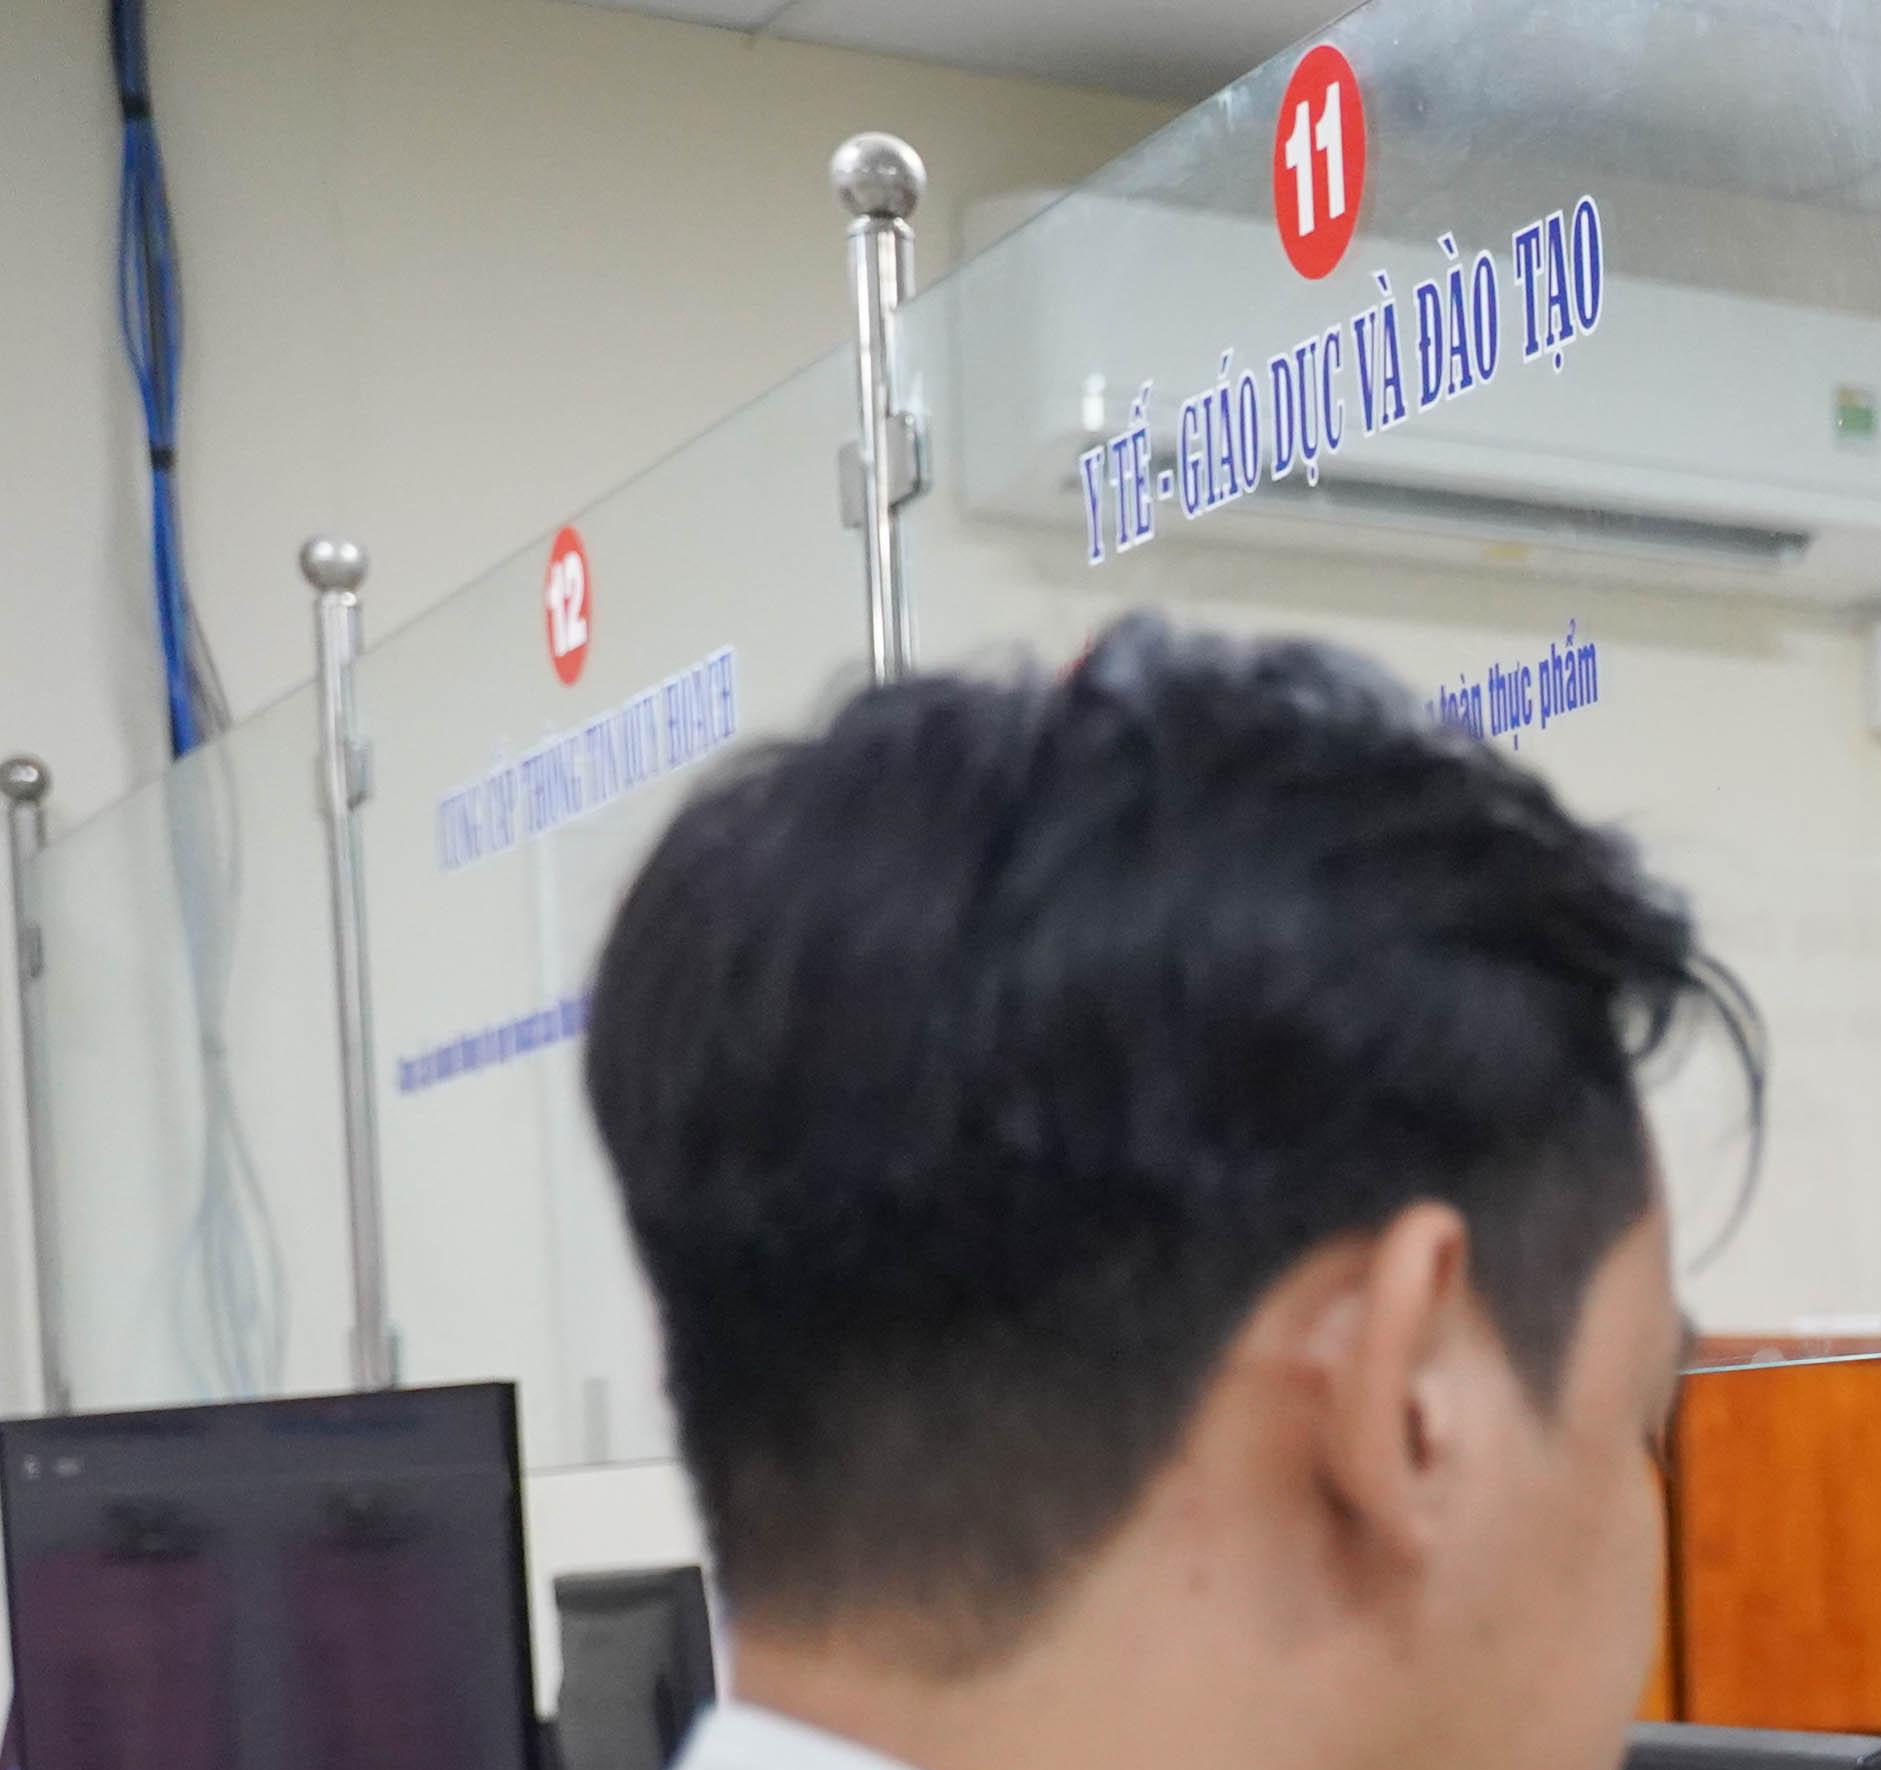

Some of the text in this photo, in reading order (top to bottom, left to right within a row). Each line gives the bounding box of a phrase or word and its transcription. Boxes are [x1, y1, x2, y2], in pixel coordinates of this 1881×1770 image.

[1284, 81, 1345, 236] 11
[1080, 452, 1104, 562] Y
[1110, 385, 1153, 547] TẾ
[1180, 350, 1260, 516] GIÁO
[1271, 327, 1342, 483] DỤC
[1353, 272, 1406, 434] VÀ
[1416, 238, 1498, 408] ĐÀO
[1516, 200, 1601, 371] TẠO
[546, 550, 587, 655] 12
[1488, 661, 1532, 750] thực
[1539, 618, 1598, 729] phẩm
